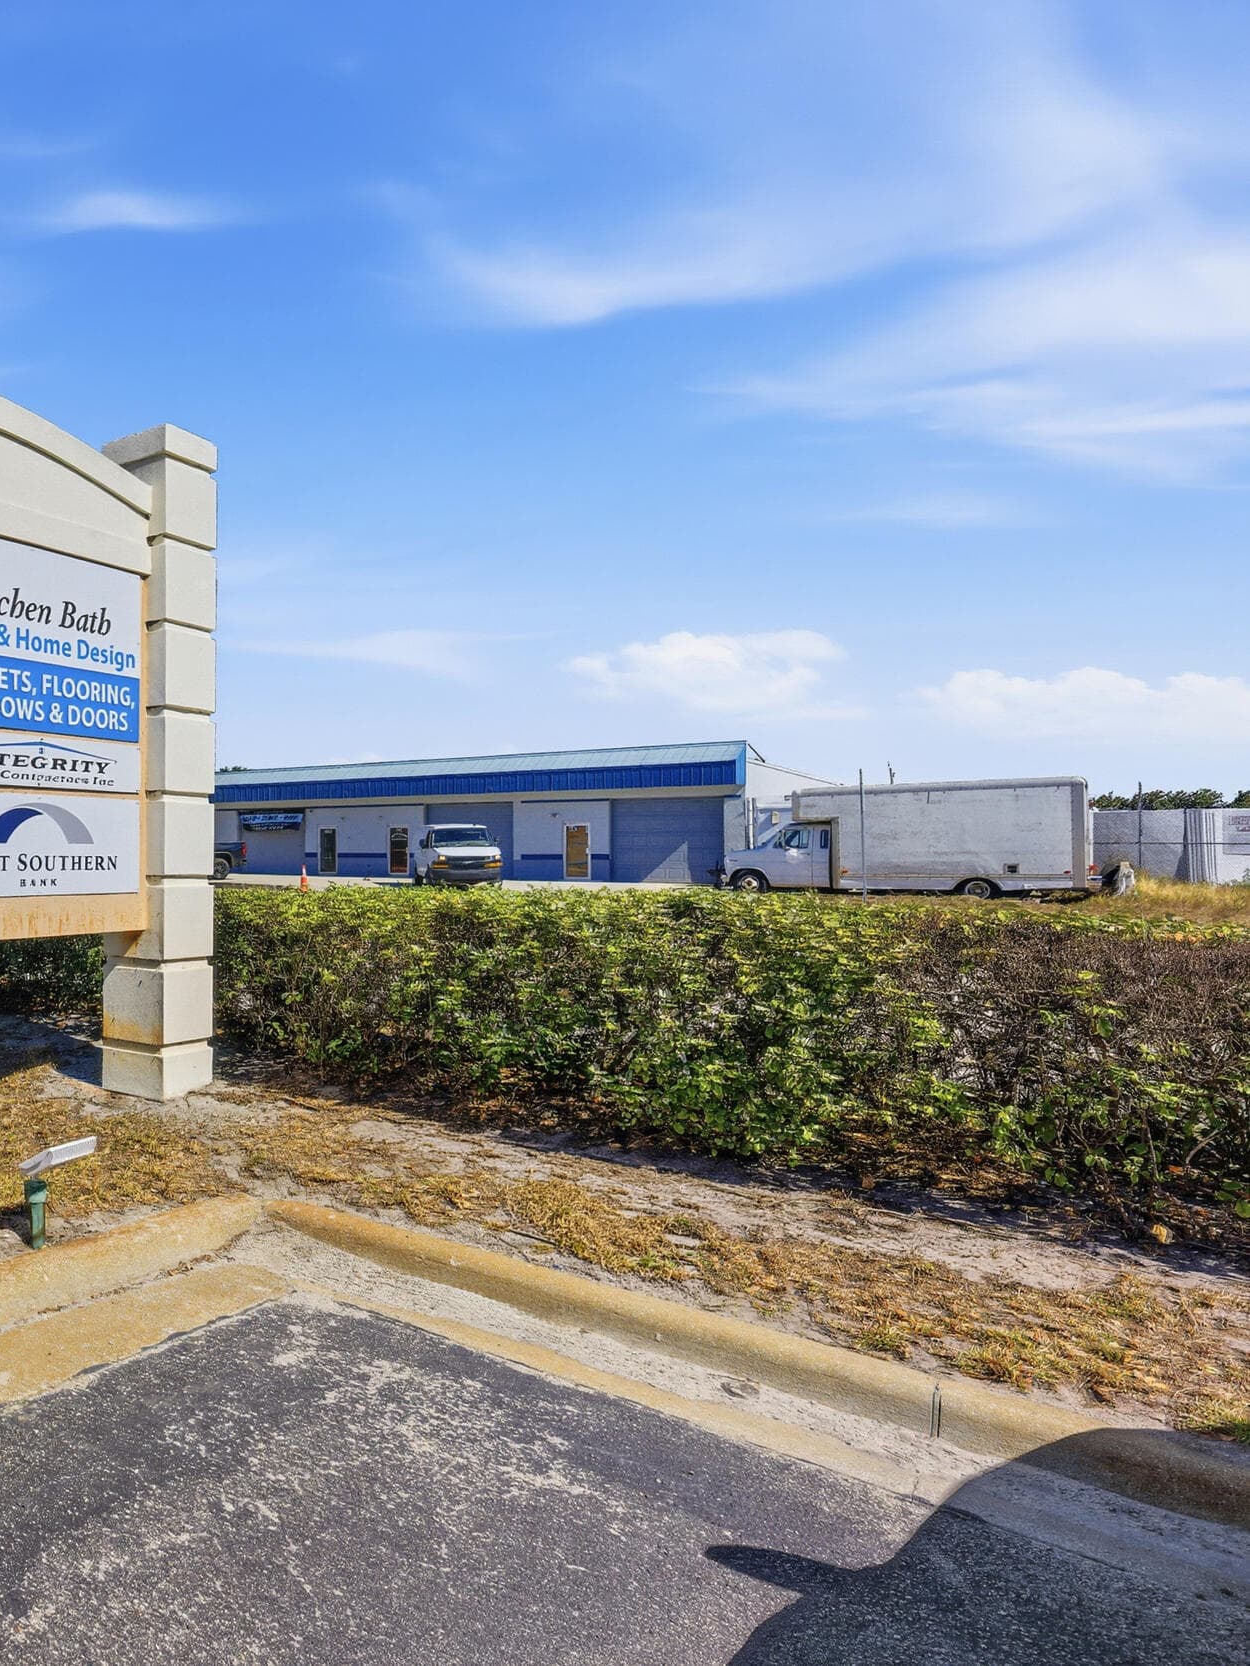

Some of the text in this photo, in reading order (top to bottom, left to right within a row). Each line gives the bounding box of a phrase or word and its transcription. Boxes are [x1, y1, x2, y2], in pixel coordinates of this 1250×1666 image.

[58, 601, 112, 636] Bath
[16, 627, 72, 657] Home
[77, 639, 136, 672] Design
[42, 674, 135, 709] FLOORING,
[50, 703, 63, 724] &
[68, 704, 128, 732] DOORS
[17, 853, 118, 872] SOUTHERN
[19, 878, 58, 887] BANK
